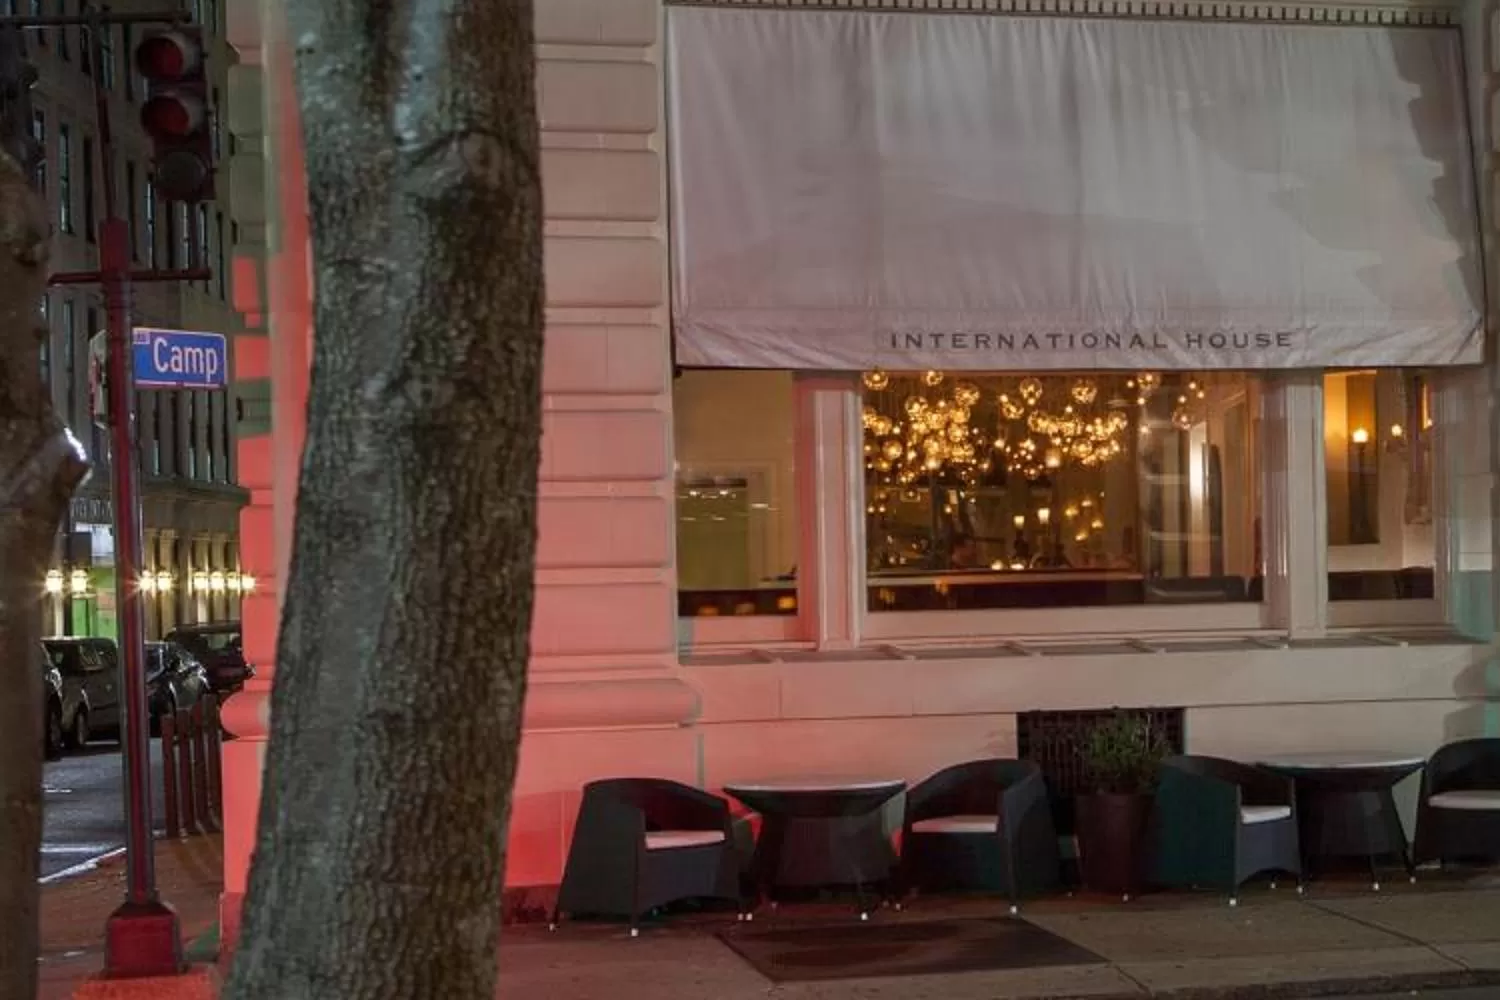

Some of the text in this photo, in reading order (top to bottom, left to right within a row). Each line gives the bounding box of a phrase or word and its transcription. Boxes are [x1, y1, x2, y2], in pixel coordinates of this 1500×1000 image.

[890, 332, 1293, 350] INTERNATIONAL HOUSE
[153, 337, 218, 382] Camp
